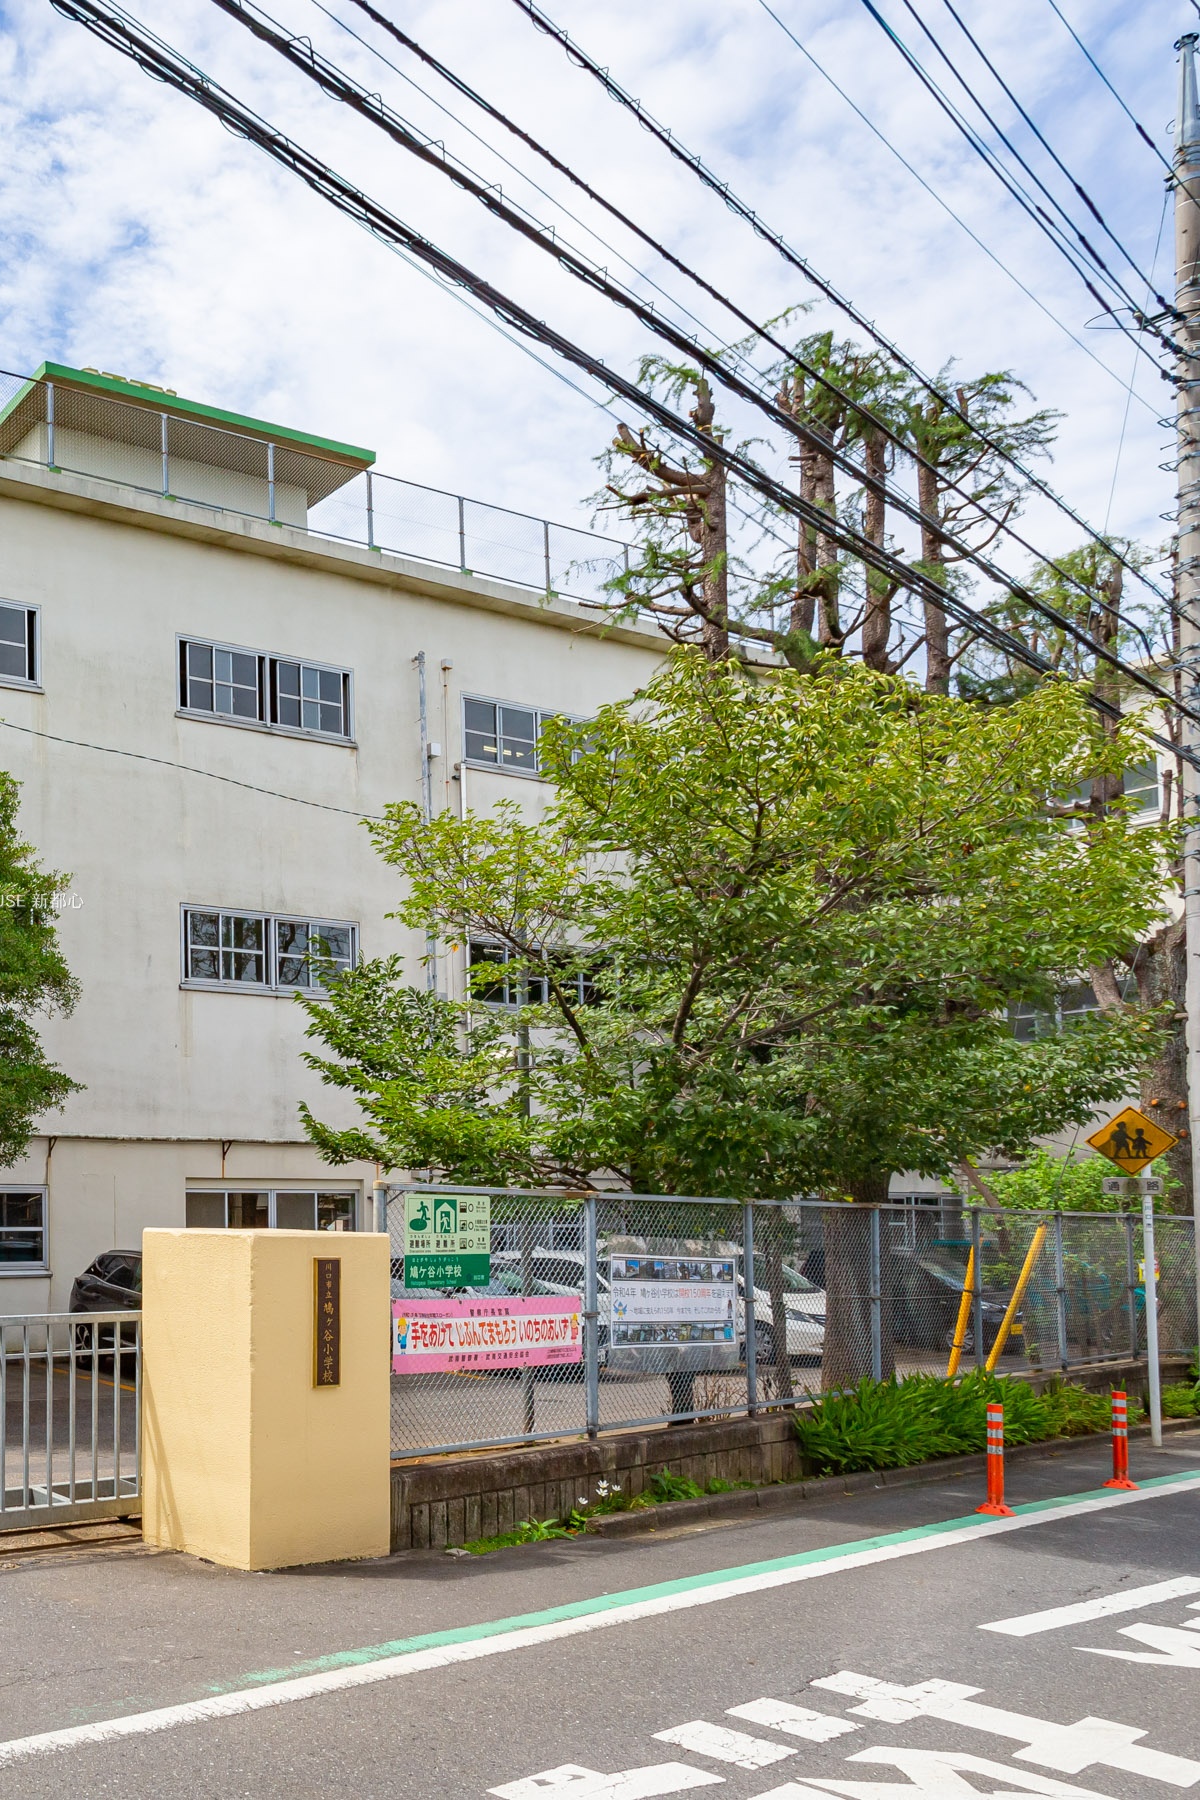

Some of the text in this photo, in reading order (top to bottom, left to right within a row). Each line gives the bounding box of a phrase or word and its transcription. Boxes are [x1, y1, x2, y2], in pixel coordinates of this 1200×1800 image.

[1107, 1181, 1160, 1191] 通路
[411, 1321, 455, 1350] 手をあげて
[455, 1319, 517, 1347] じぶんでまもろう
